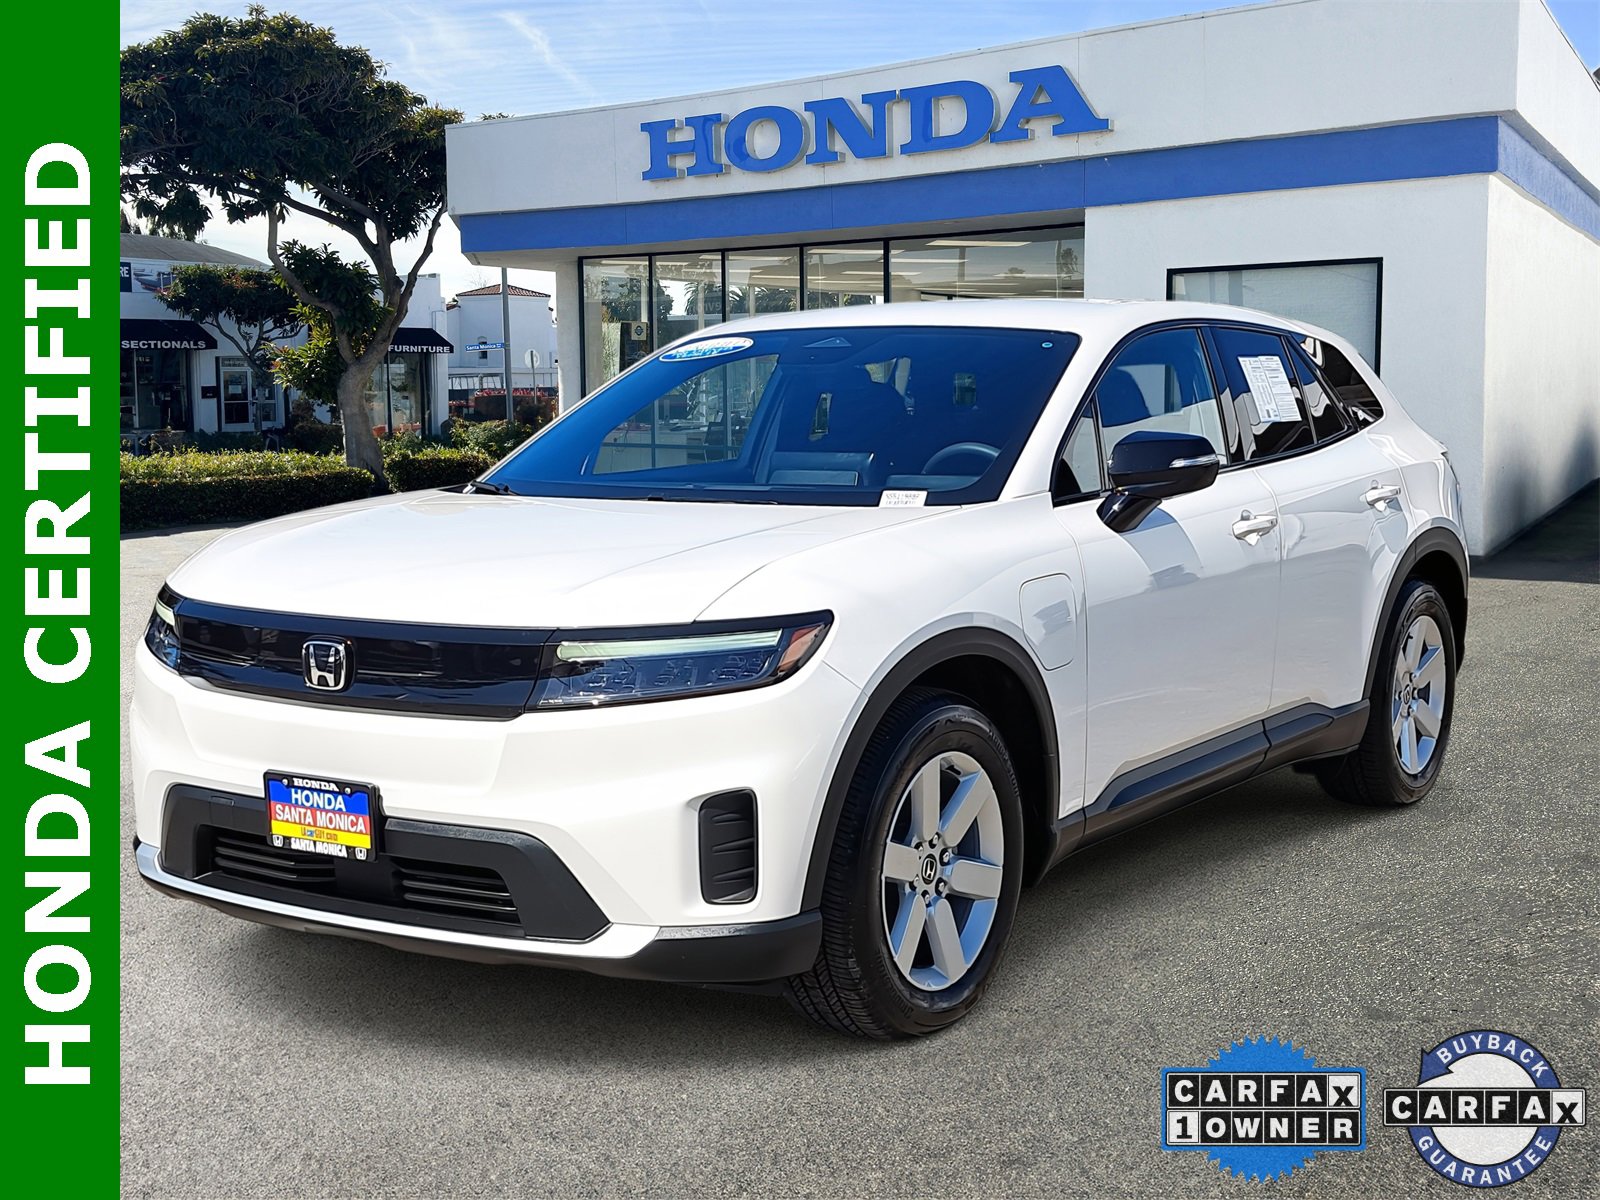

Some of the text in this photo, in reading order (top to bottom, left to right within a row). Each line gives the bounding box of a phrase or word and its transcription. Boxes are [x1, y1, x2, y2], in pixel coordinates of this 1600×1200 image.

[641, 65, 1111, 181] HONDA
[120, 339, 207, 350] SECTIONALS
[388, 344, 451, 353] FURNITURE
[292, 777, 340, 792] HONDA
[290, 788, 347, 812] HONDA
[275, 804, 315, 826] SANTA
[316, 811, 367, 834] MONICA
[290, 837, 348, 858] SANTA MONICA
